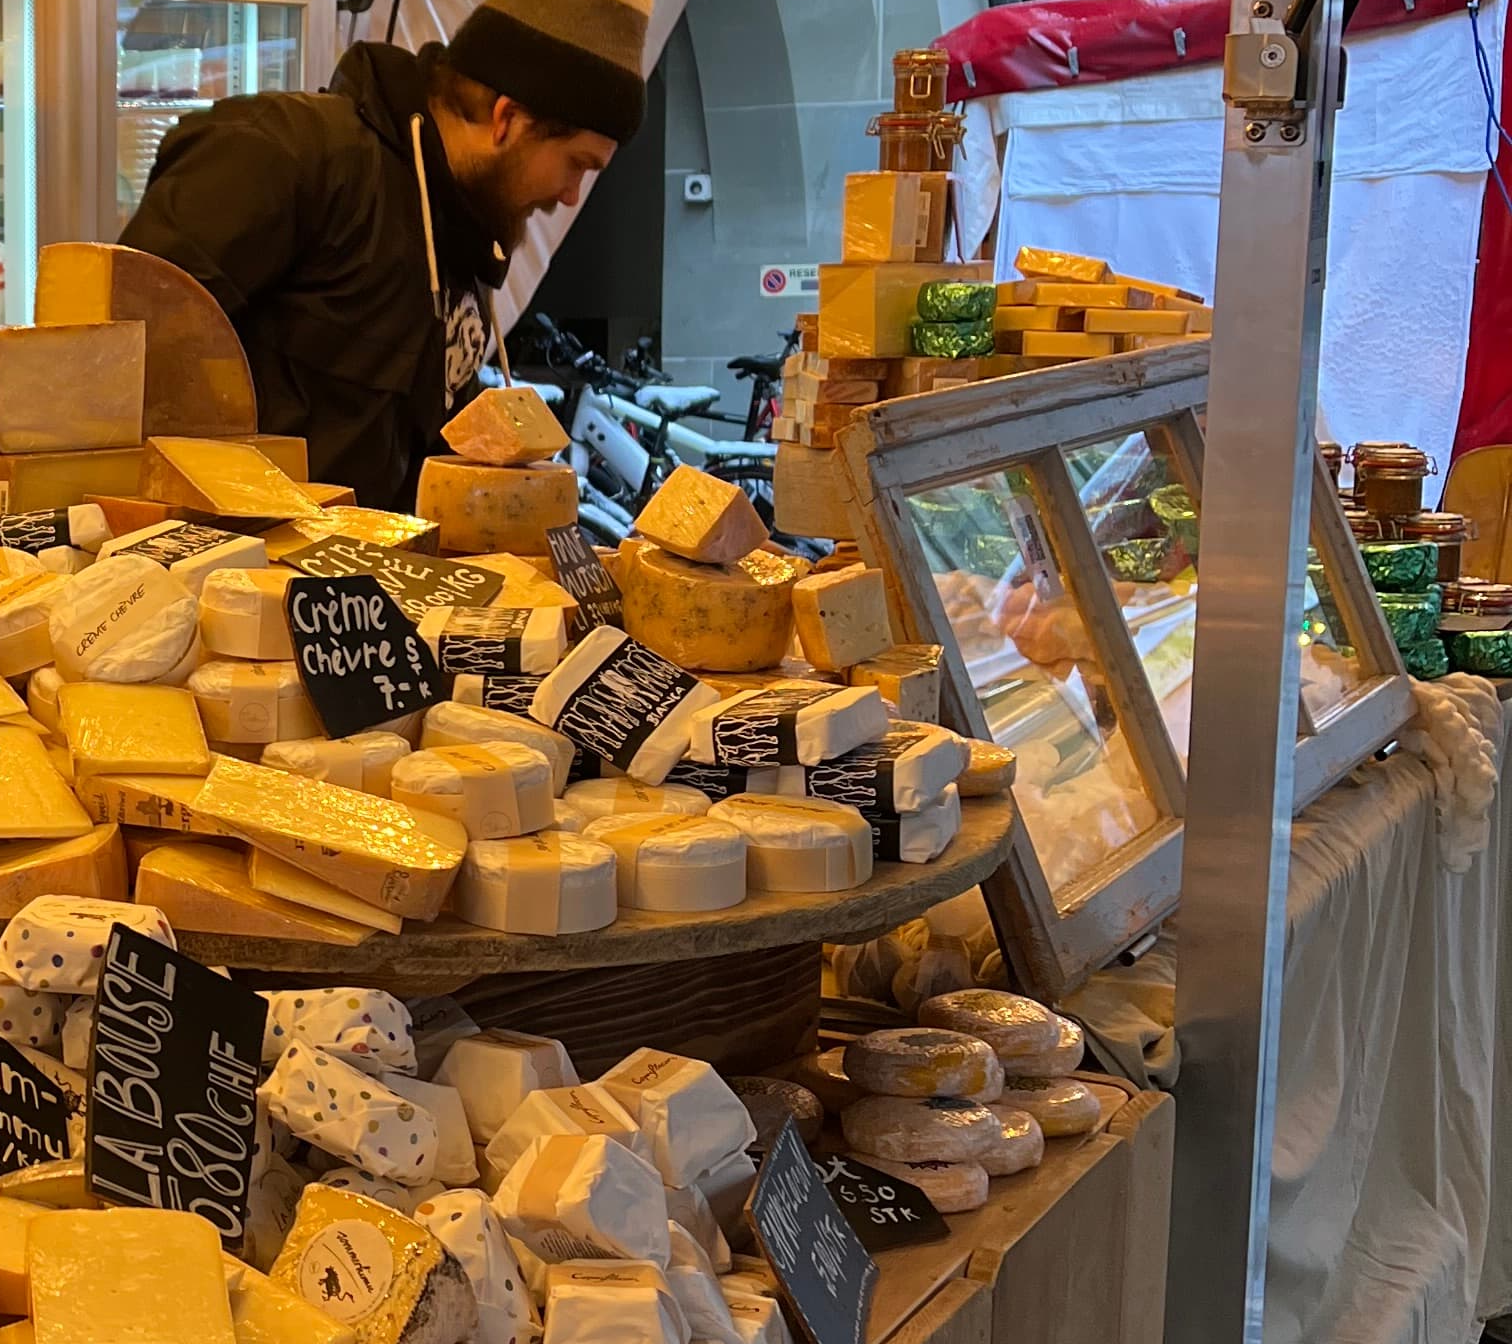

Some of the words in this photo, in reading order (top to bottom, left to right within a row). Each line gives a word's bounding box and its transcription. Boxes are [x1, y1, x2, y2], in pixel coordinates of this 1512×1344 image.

[75, 620, 109, 658] CRÈME
[109, 582, 147, 624] CHÈVRE
[292, 585, 388, 635] Crème
[302, 634, 397, 677] Chèvre
[644, 685, 688, 728] BIANCA
[92, 931, 177, 1129] BOUSE
[92, 1133, 164, 1209] LA
[870, 1207, 921, 1225] STK
